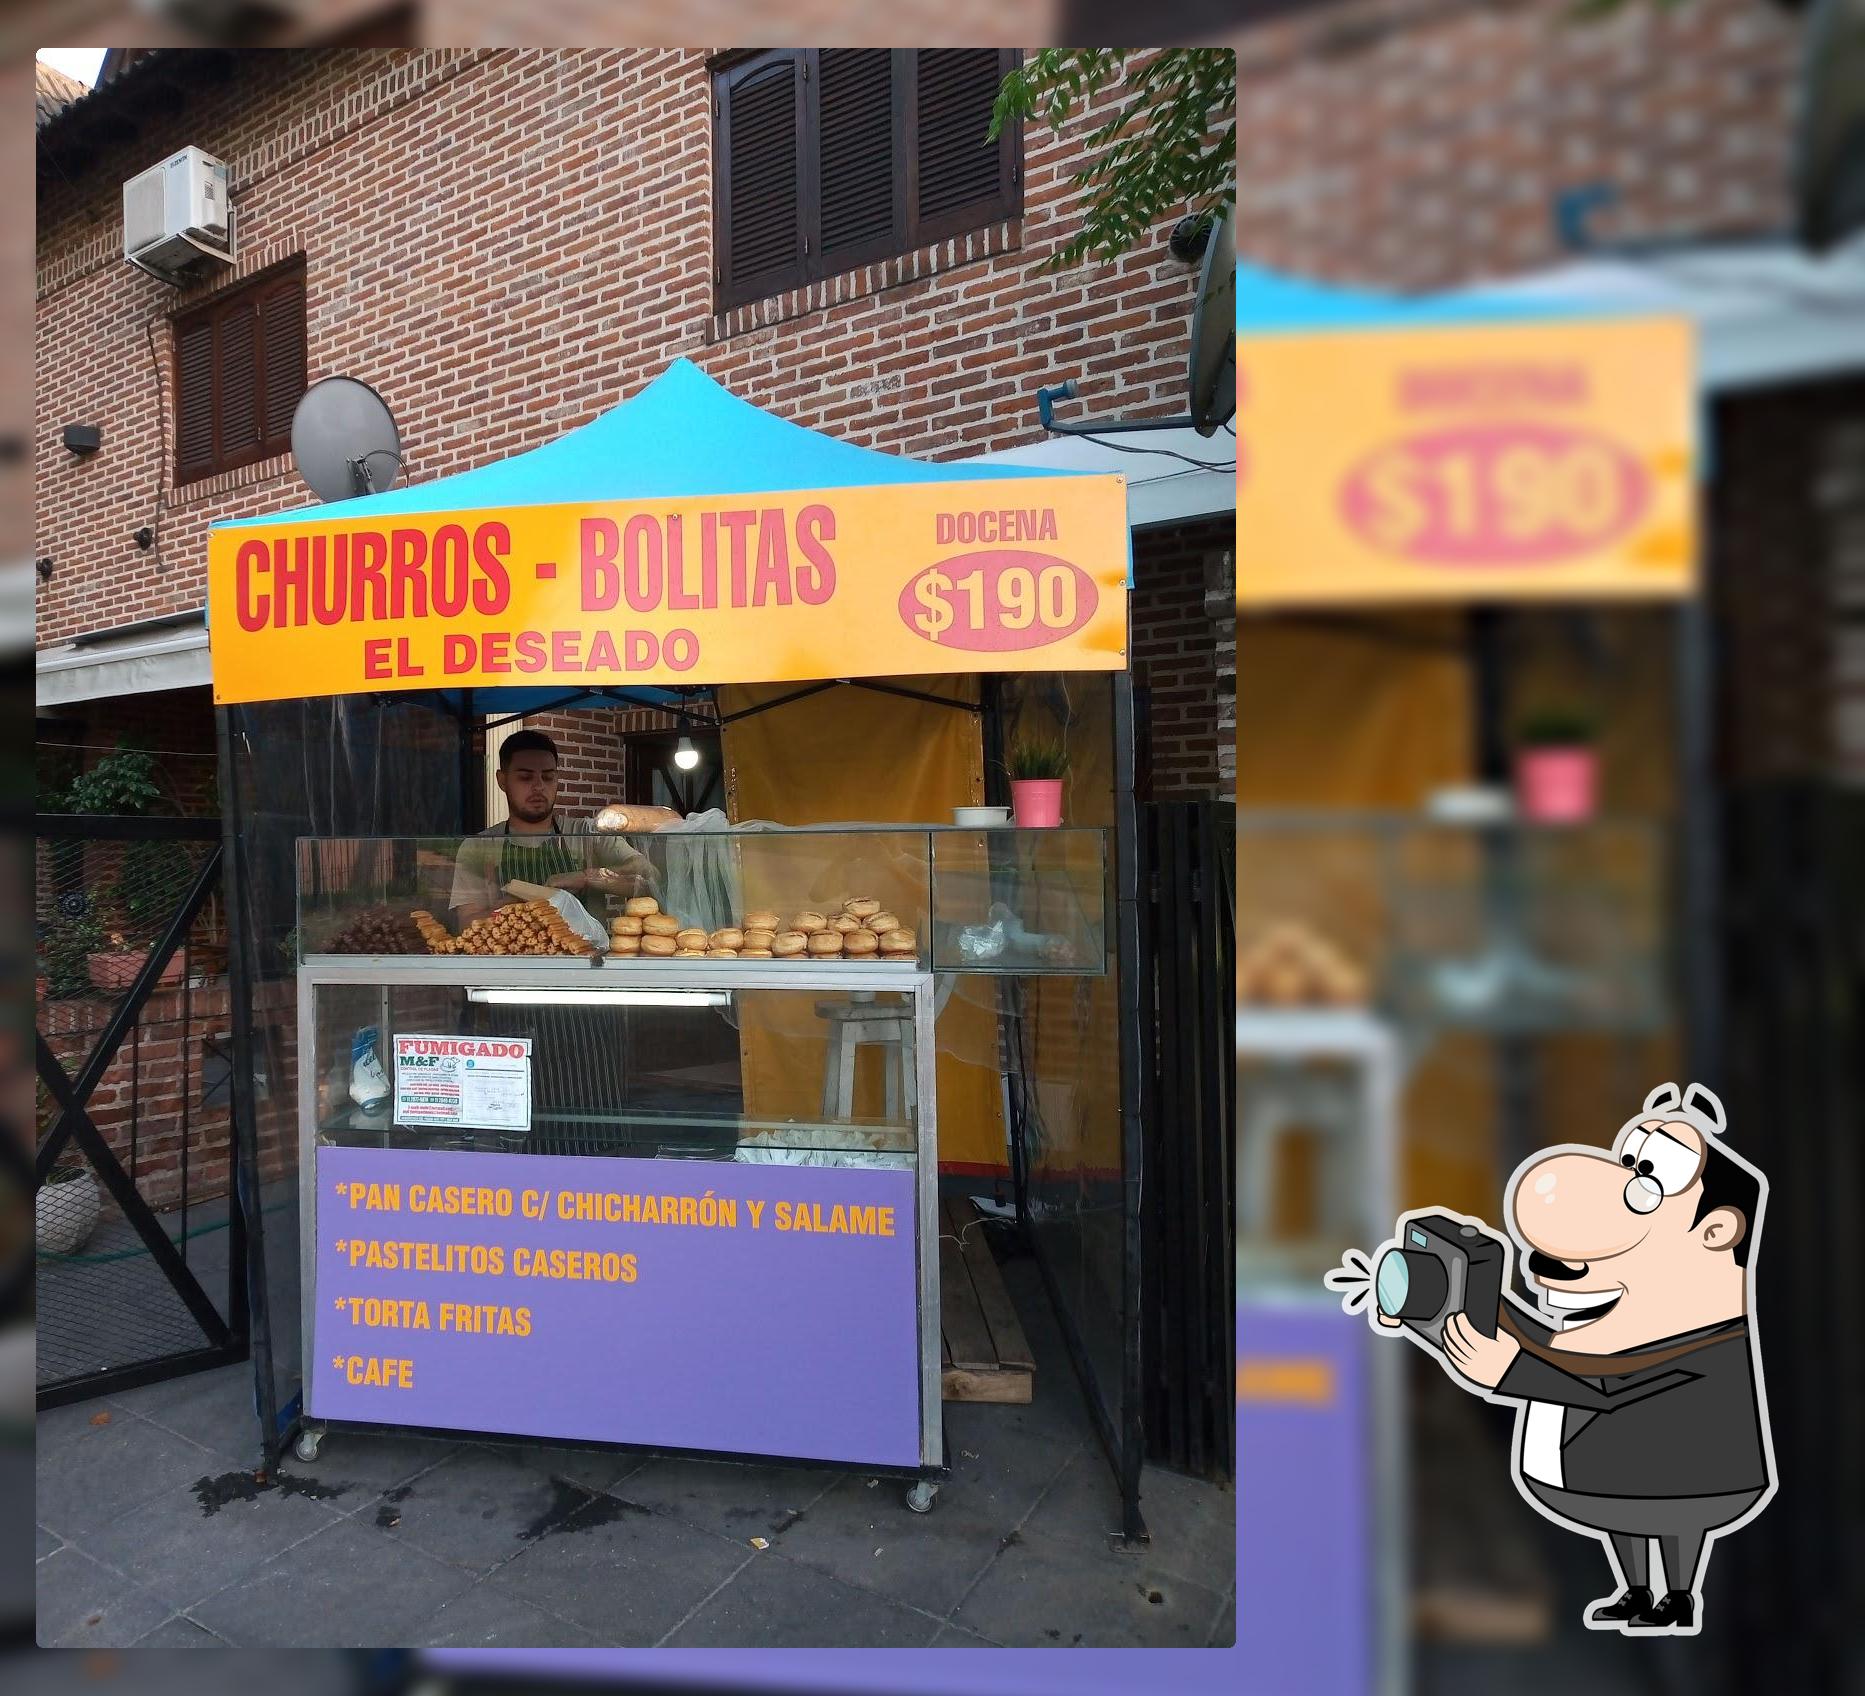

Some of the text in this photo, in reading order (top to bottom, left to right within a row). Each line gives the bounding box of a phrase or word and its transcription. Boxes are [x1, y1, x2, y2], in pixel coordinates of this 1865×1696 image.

[936, 508, 1059, 545] DOCENA
[236, 522, 510, 632] CHURROS
[581, 504, 836, 613] BOLITAS
[913, 565, 1078, 641] $190
[364, 627, 700, 679] EL DESEADO
[399, 1041, 525, 1059] FUMIGADO
[400, 1056, 439, 1067] M&F
[409, 1184, 513, 1217] CASERO
[521, 1189, 550, 1221] C/
[557, 1190, 737, 1228] CHICHARRÓN
[746, 1200, 765, 1229] Y
[774, 1201, 896, 1237] SALAME
[513, 1247, 638, 1283] CASEROS
[439, 1302, 532, 1336] FRITAS
